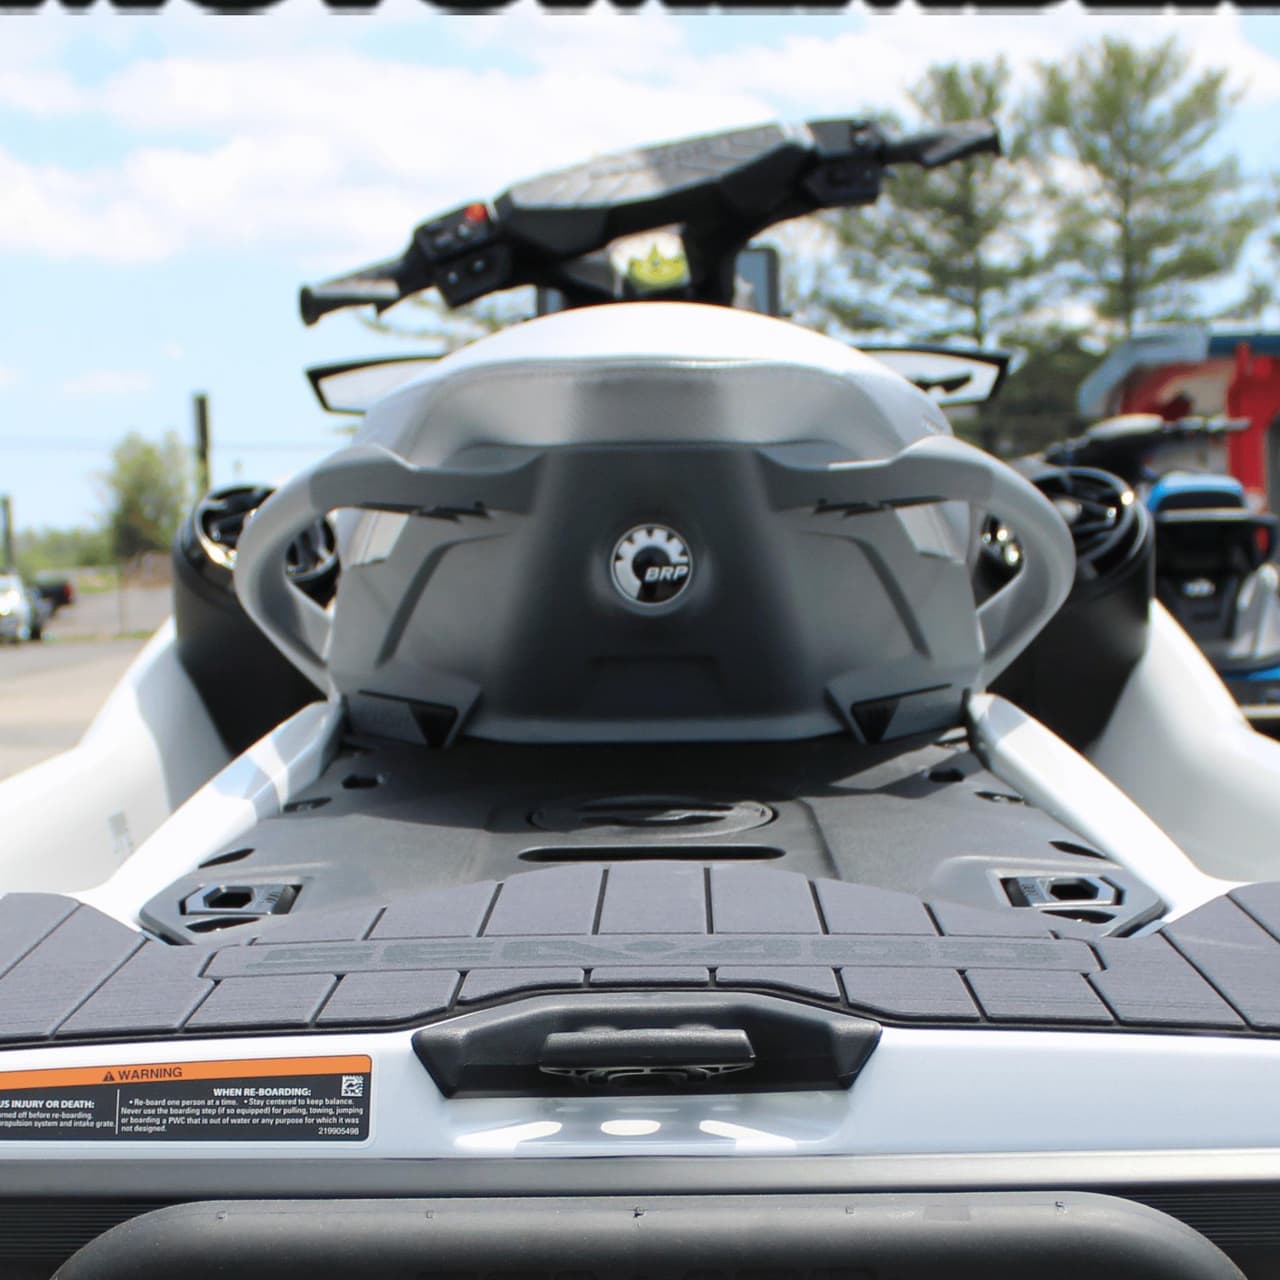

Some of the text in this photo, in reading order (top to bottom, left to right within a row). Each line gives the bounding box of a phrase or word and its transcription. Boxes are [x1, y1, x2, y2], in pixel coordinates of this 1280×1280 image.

[645, 565, 689, 582] BRP
[119, 1067, 183, 1080] WARNING
[213, 1087, 312, 1097] WHEN RE-BOARDING:
[11, 1099, 43, 1109] INJURY
[46, 1099, 60, 1109] OR
[61, 1099, 95, 1109] DEATH:
